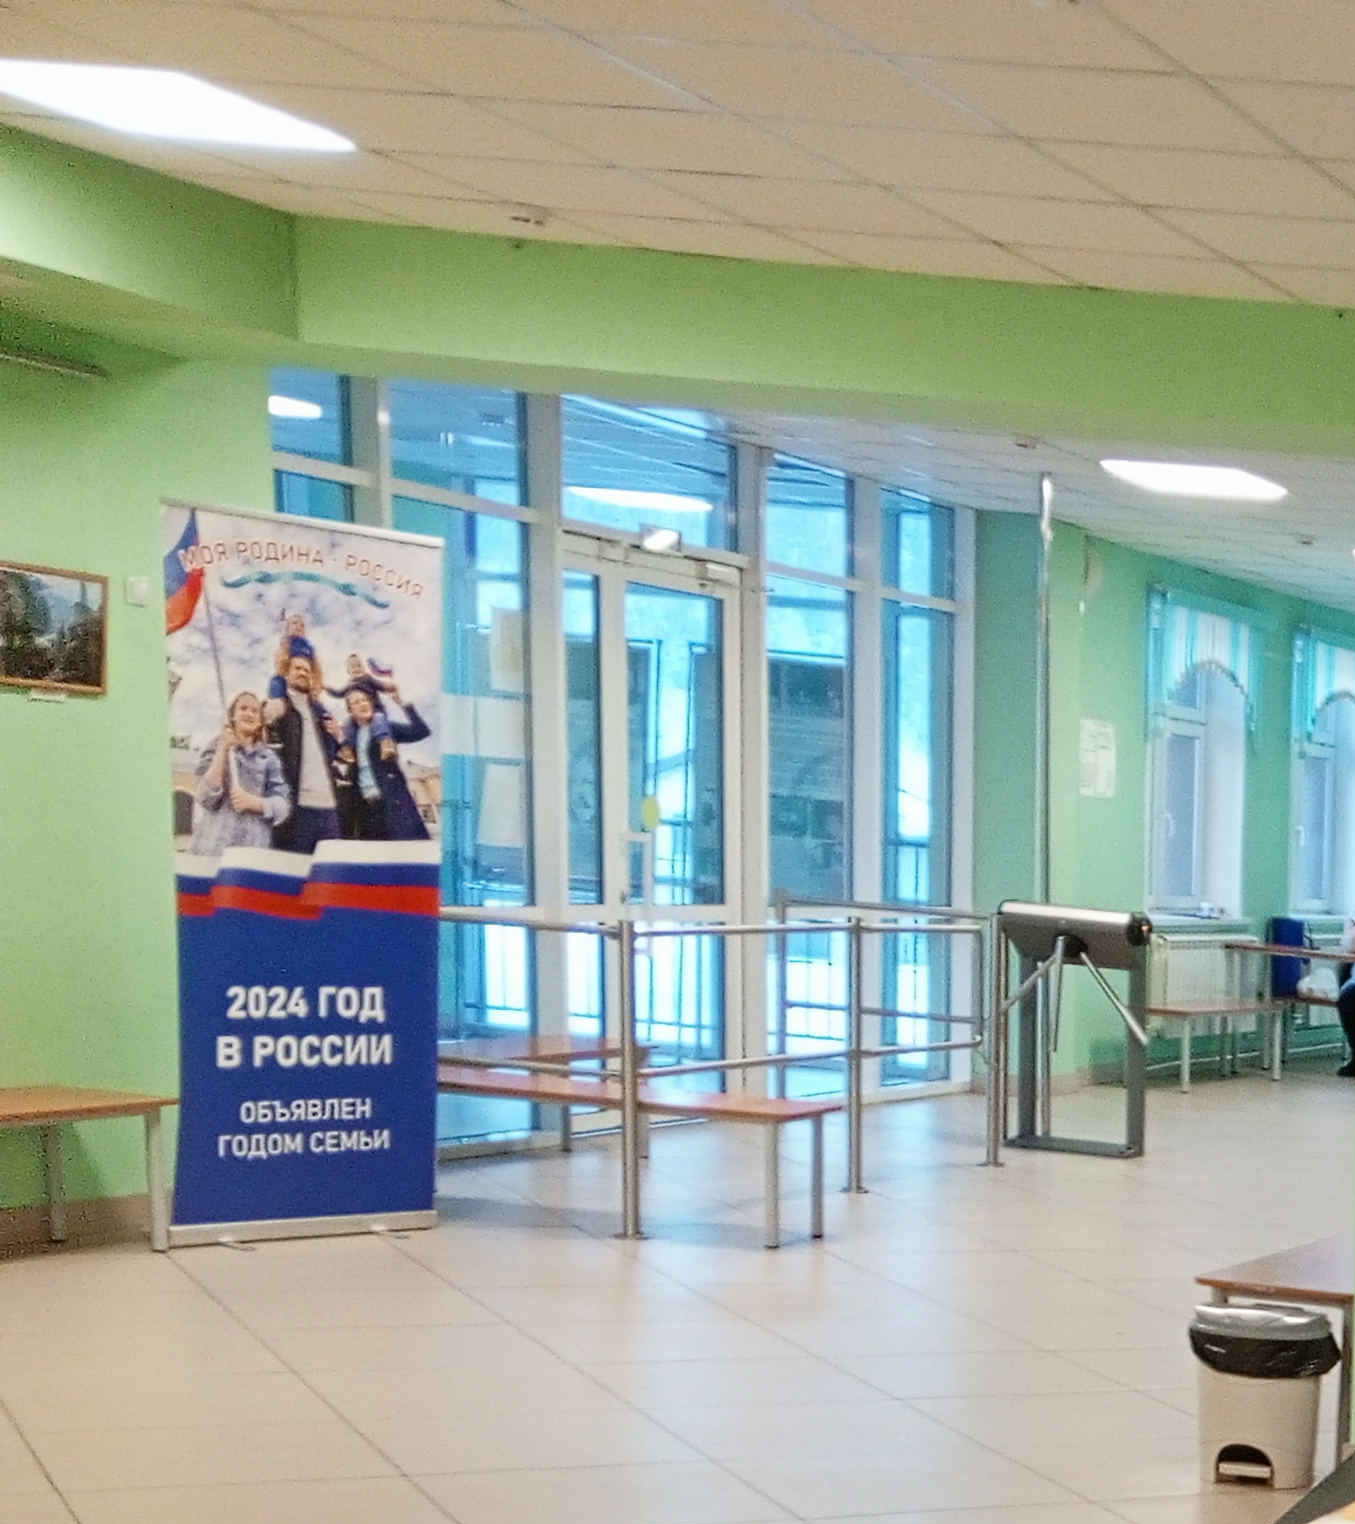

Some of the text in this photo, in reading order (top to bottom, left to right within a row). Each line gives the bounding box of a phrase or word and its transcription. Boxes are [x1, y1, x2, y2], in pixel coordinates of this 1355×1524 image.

[178, 543, 227, 570] МОЯ
[235, 541, 324, 565] РОДИНА
[346, 555, 424, 598] РОССИЯ
[226, 986, 385, 1023] 2024 ГОД
[216, 1035, 393, 1067] В РОССИИ
[240, 1098, 372, 1123] ОБЪЯВЛЕН
[218, 1130, 390, 1158] ГОДОМ СЕМЬИ
